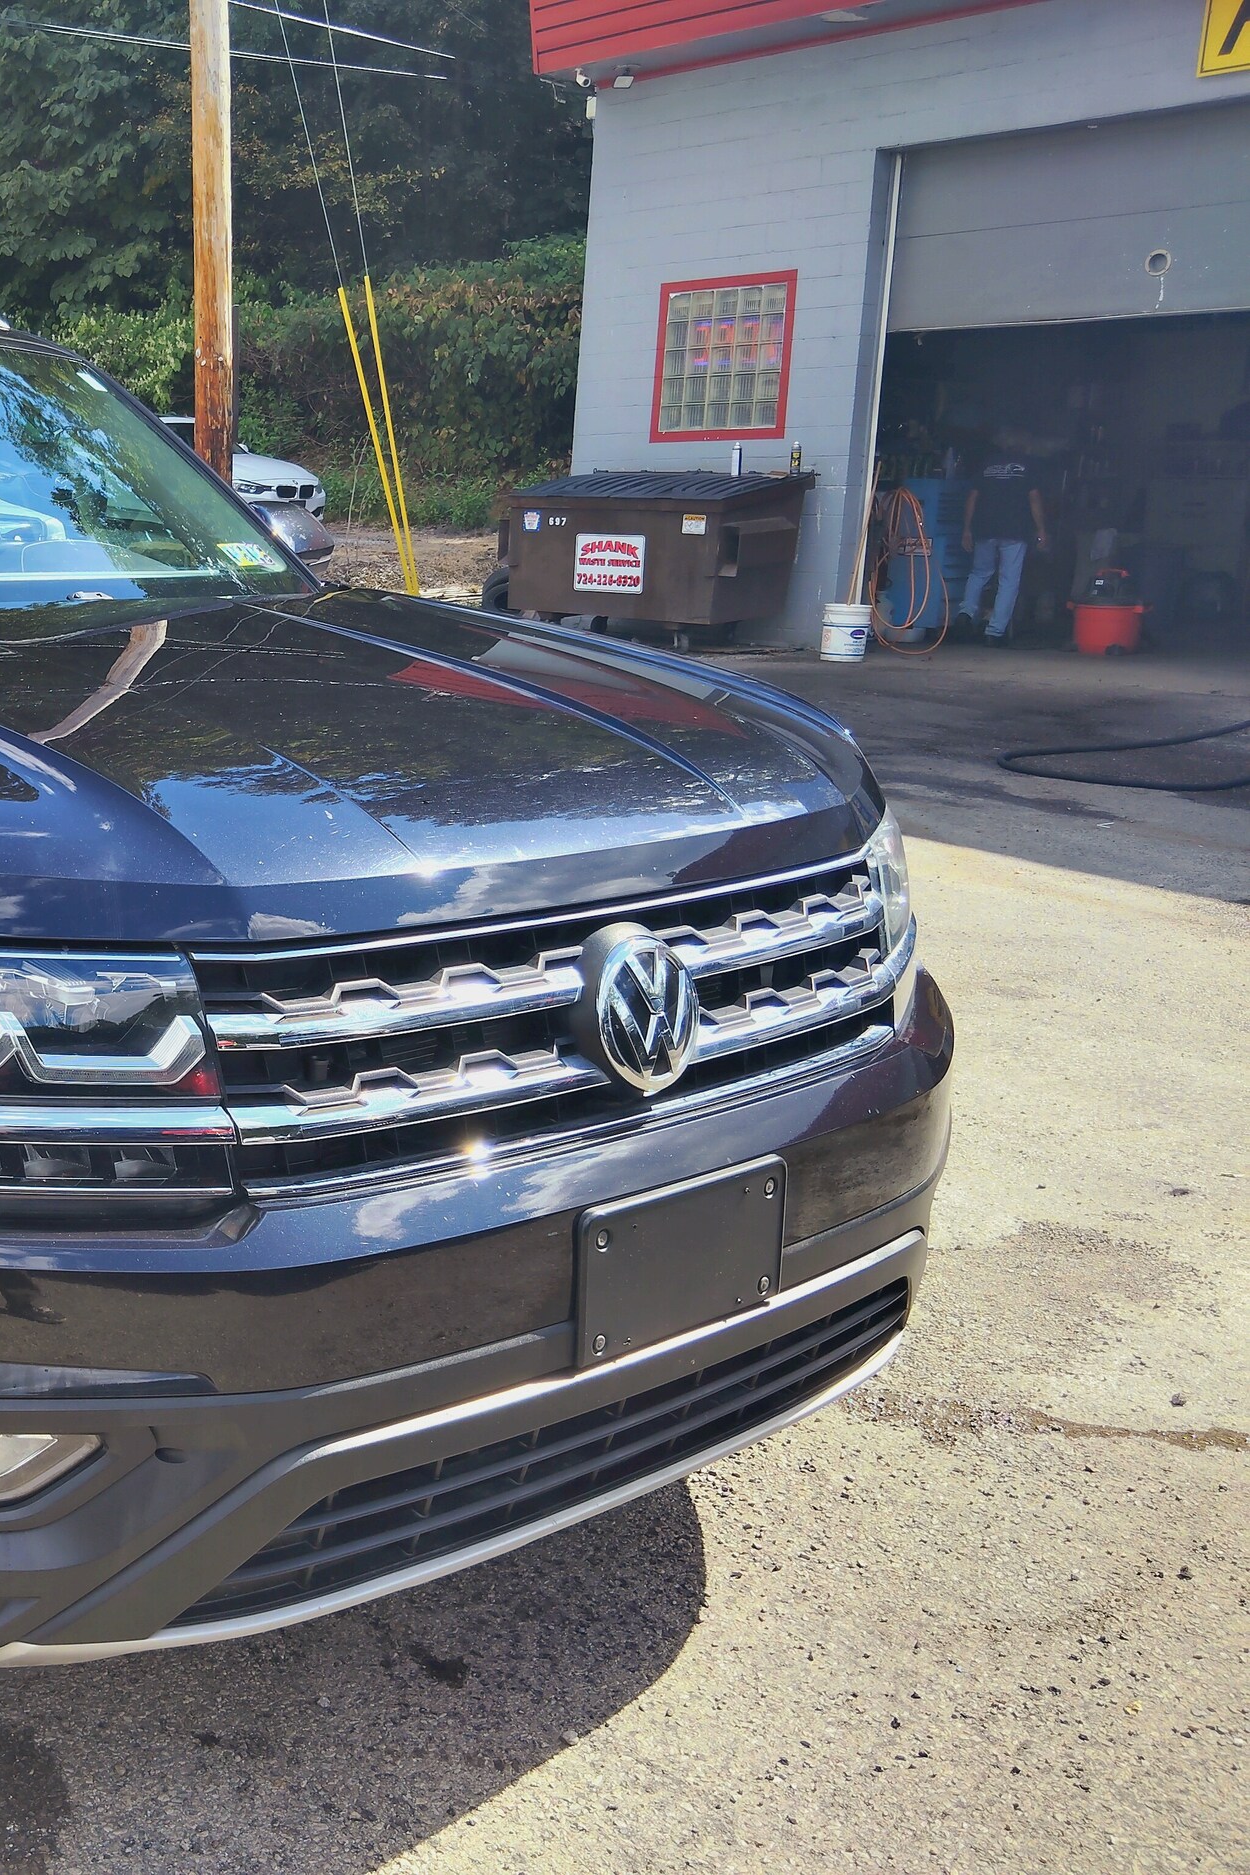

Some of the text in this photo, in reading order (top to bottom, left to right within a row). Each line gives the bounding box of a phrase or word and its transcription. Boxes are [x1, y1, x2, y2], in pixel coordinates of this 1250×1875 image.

[549, 517, 567, 526] 697
[581, 540, 639, 559] SHANK
[579, 558, 641, 568] WASTE SERVICE
